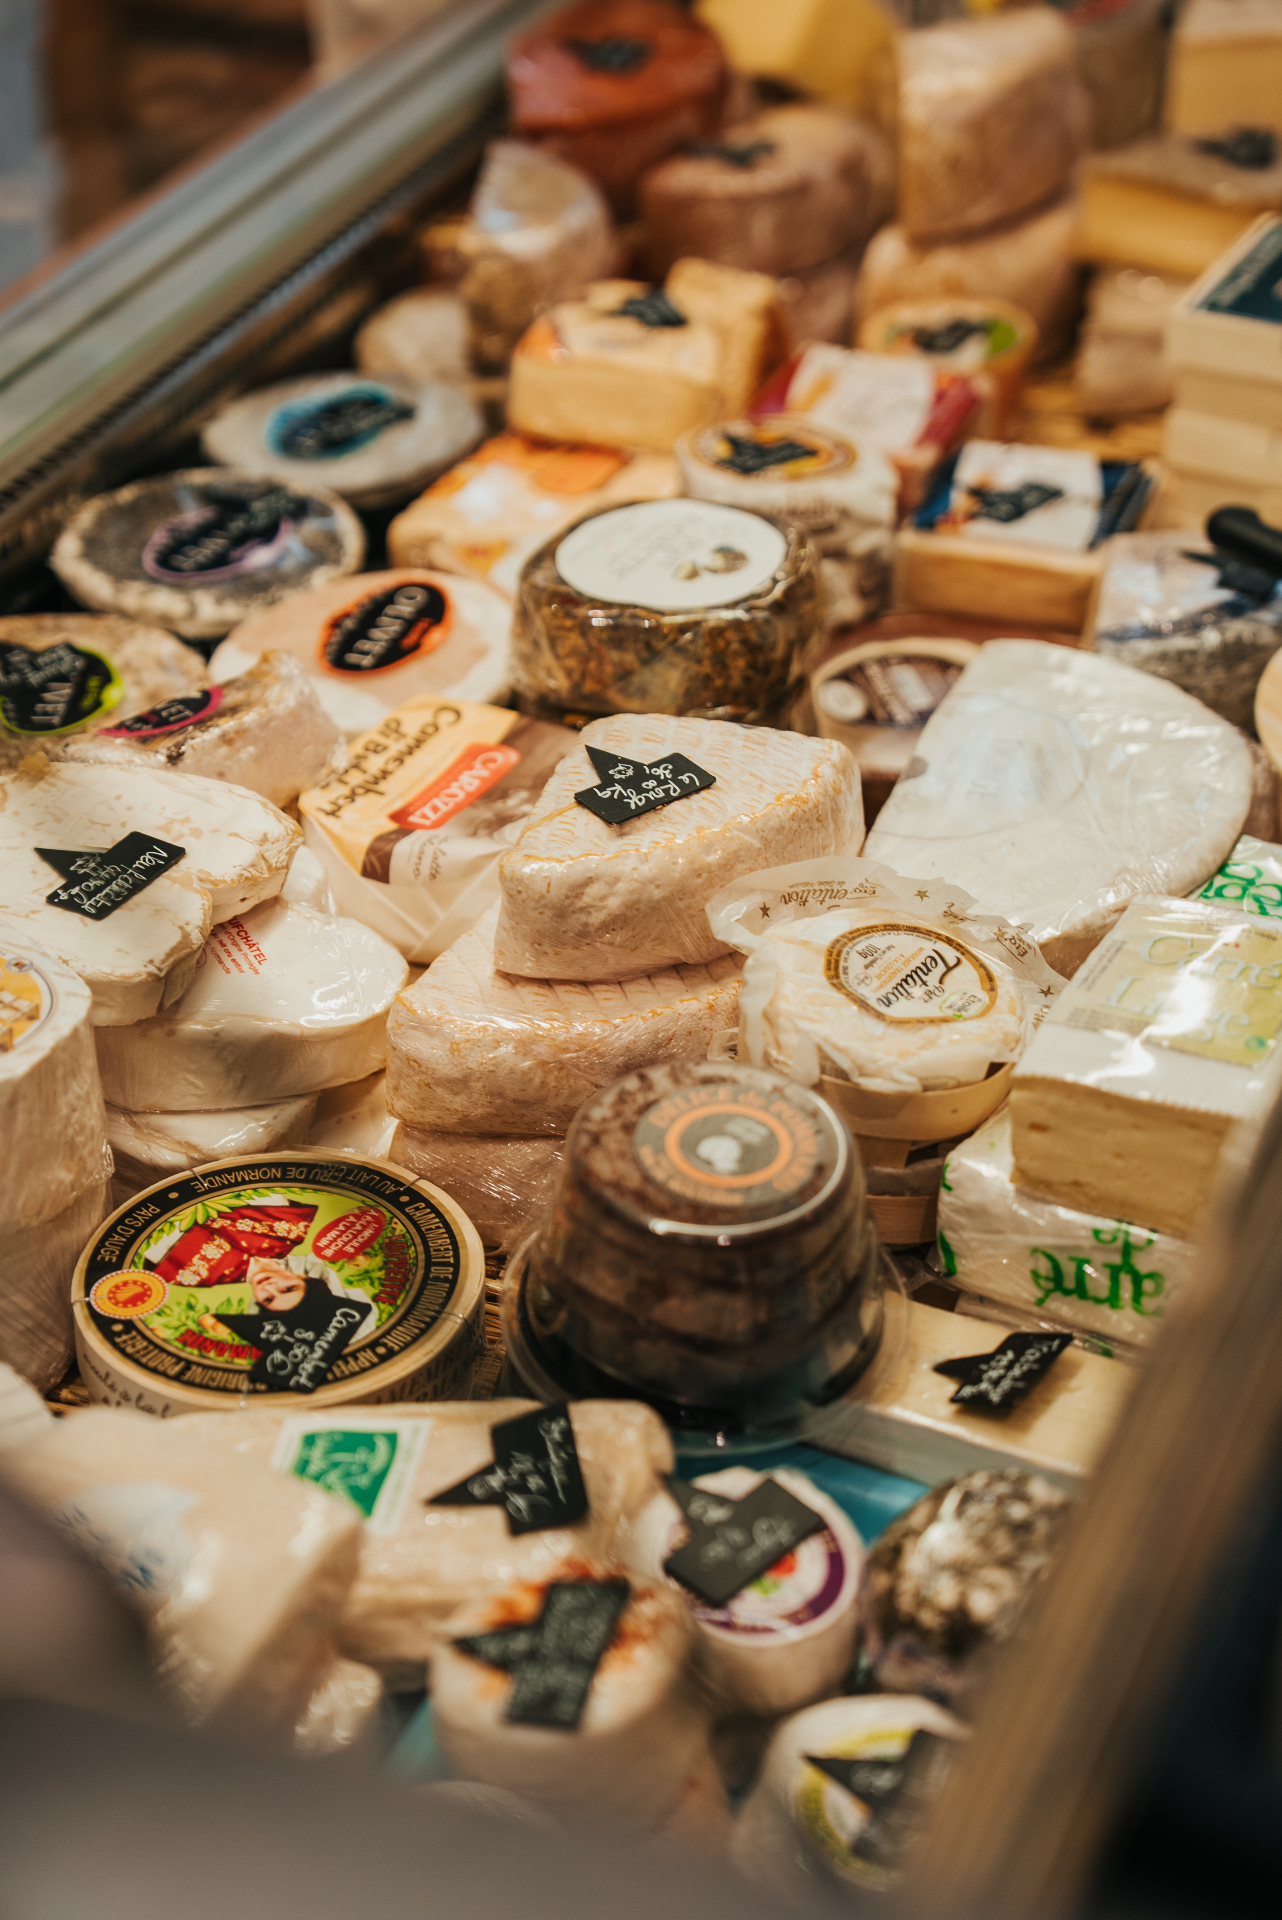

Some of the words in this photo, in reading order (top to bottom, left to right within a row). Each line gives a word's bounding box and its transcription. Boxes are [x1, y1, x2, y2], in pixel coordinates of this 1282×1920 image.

[344, 585, 430, 670] OLIVET
[376, 717, 407, 739] di
[315, 705, 461, 819] Camembert
[407, 751, 505, 826] CAROZZI
[623, 780, 682, 810] Rouge
[780, 886, 848, 906] entation
[228, 916, 267, 966] UFCHÂTEL
[856, 944, 881, 959] 100g
[900, 946, 926, 968] MOULAGE
[876, 948, 963, 1008] Tentation
[190, 1167, 282, 1193] NORMANDIE
[285, 1167, 307, 1179] DE
[124, 1202, 161, 1228] PAYS
[96, 1225, 135, 1263] D'AUGE
[316, 1230, 340, 1248] MAIN
[404, 1202, 455, 1263] CAMEMBERT
[430, 1266, 453, 1282] DE
[379, 1281, 450, 1352] NORMANDIE
[289, 1308, 361, 1389] Camembert
